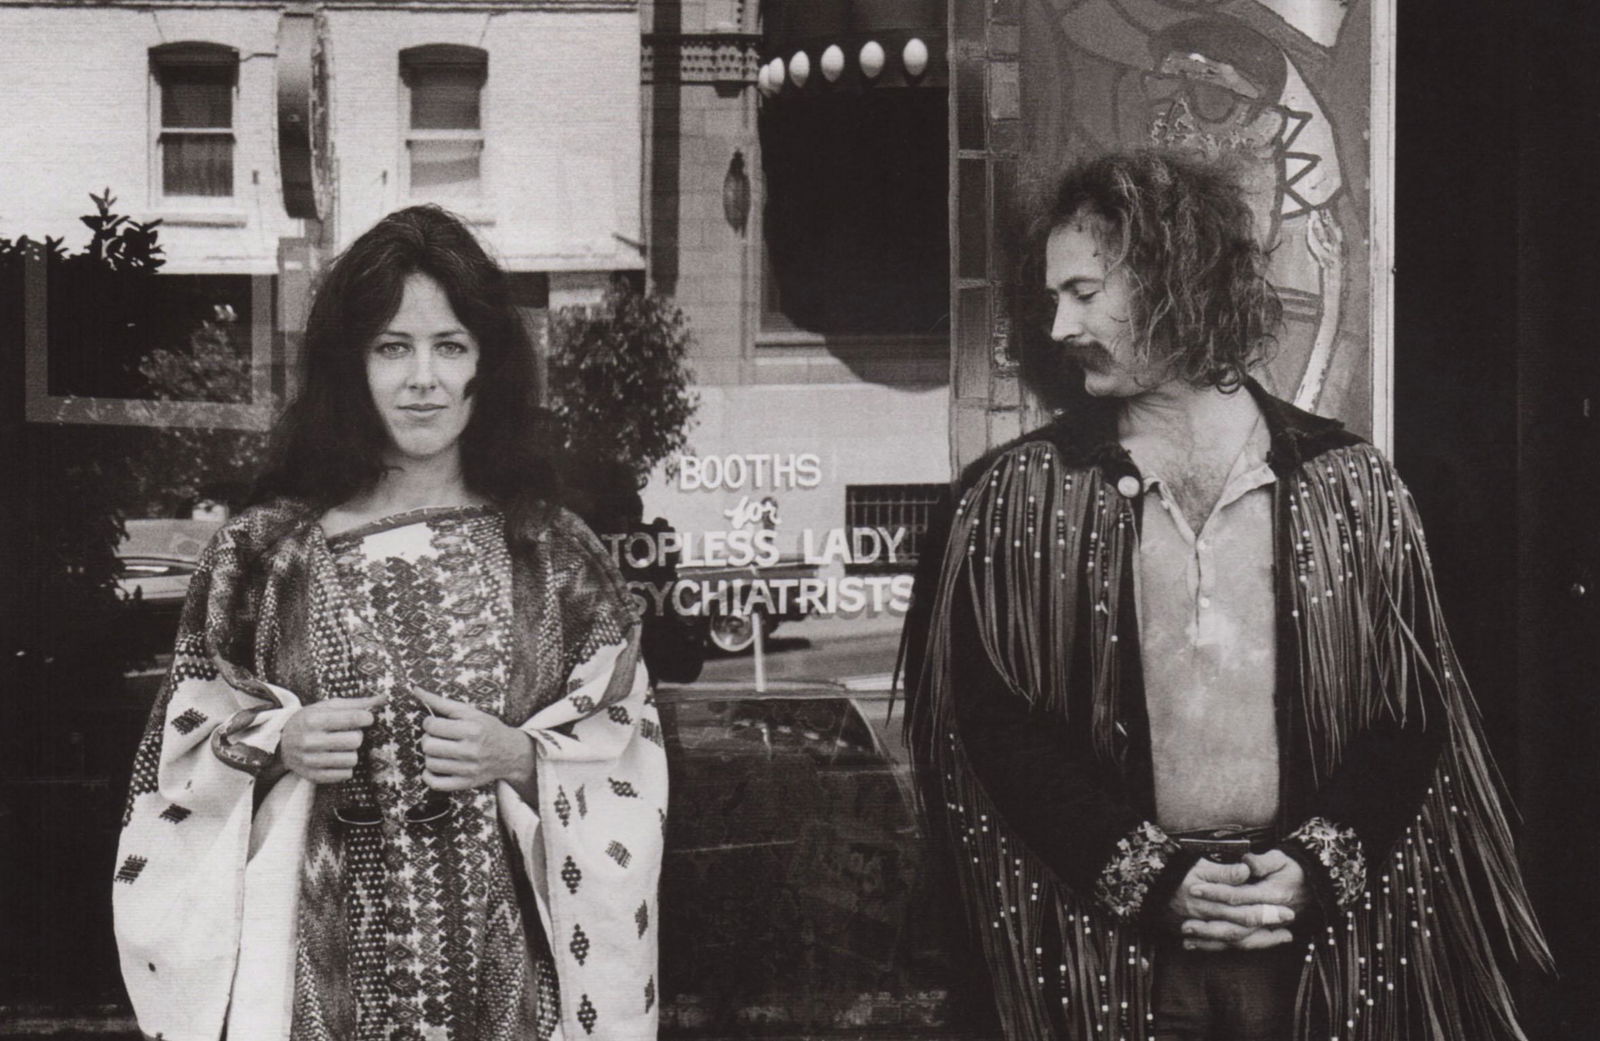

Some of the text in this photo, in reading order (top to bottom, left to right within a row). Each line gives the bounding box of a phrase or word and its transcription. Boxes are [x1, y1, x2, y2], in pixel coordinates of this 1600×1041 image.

[680, 453, 821, 489] BOOTHS
[724, 496, 781, 529] for
[602, 527, 906, 568] TOPLESS LADY
[626, 575, 915, 616] SYCHIATRISTS
